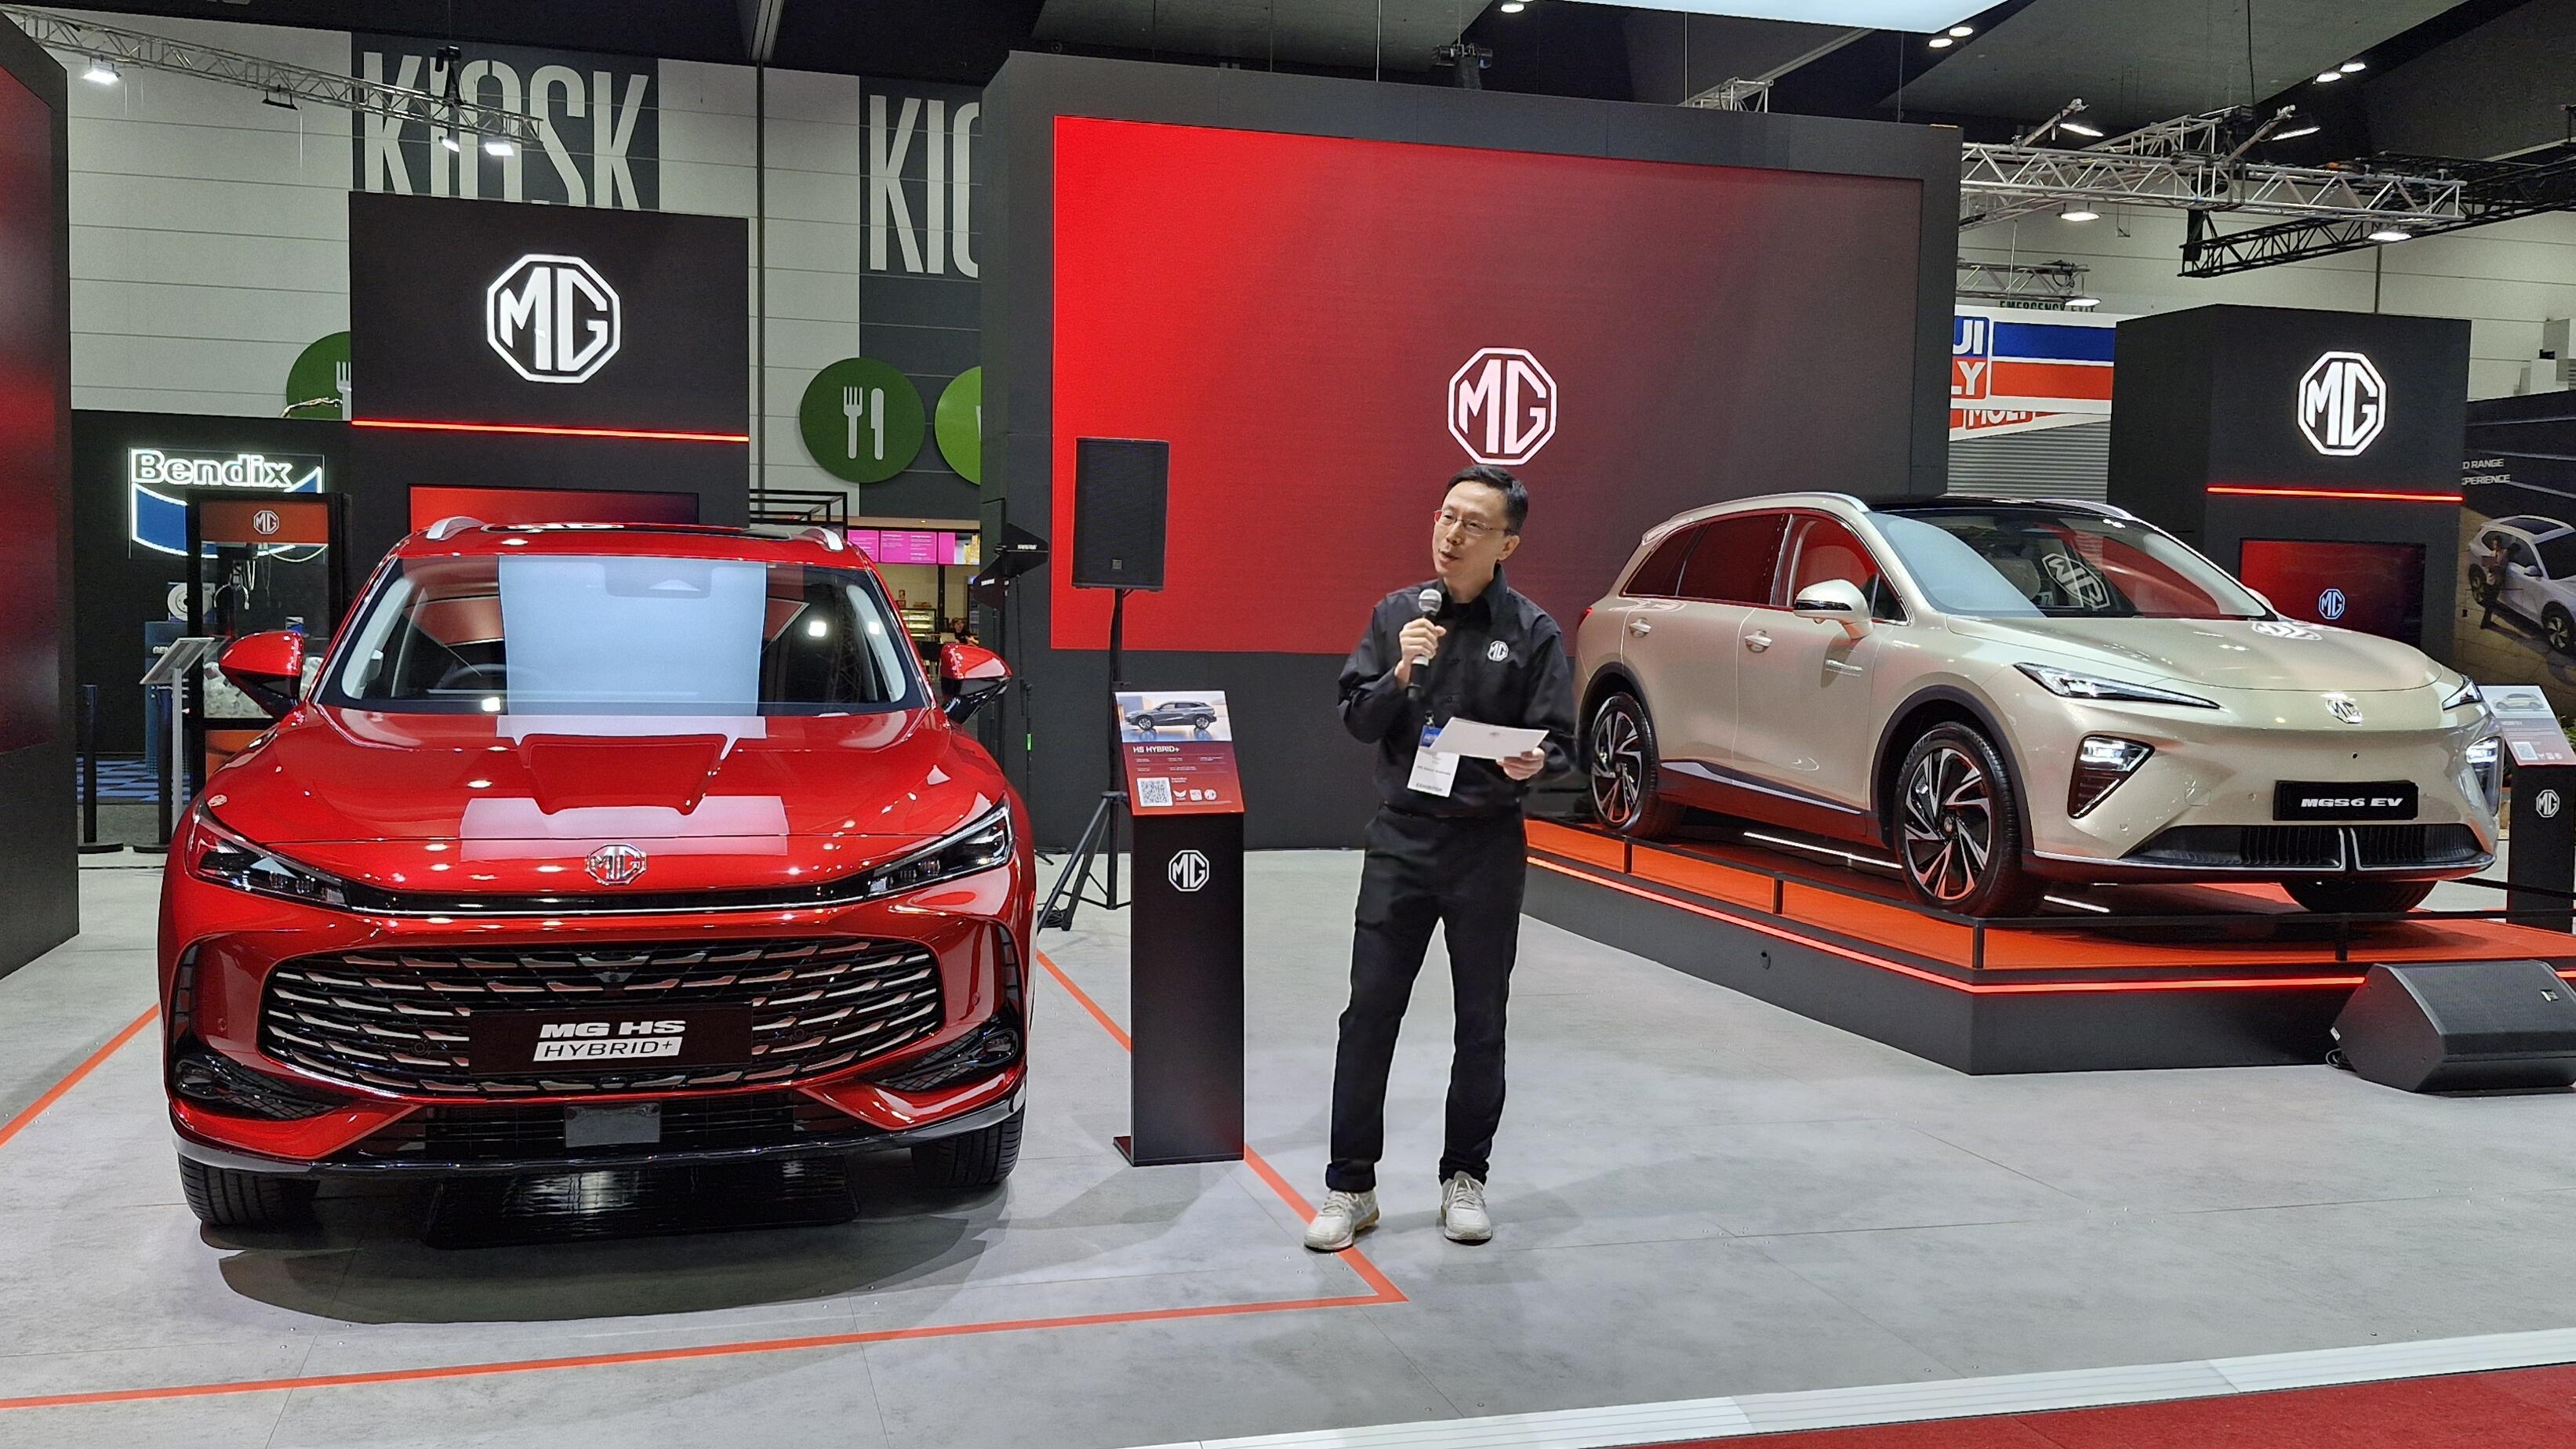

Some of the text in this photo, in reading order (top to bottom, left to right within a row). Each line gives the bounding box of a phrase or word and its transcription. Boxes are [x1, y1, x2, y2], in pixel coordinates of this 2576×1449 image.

[363, 52, 649, 210] KIOSK
[496, 262, 612, 375] MG
[1455, 356, 1550, 456] MG
[2304, 358, 2380, 448] MG
[131, 448, 294, 488] Bendix
[2471, 458, 2505, 468] RANGE
[256, 512, 278, 532] MG
[2320, 590, 2344, 618] MG
[1488, 641, 1507, 660] MG
[2301, 797, 2403, 808] MGS6 EV
[2538, 790, 2558, 816] MG
[587, 844, 645, 882] MG
[1172, 852, 1206, 888] MG
[540, 1020, 686, 1038] MG HS
[543, 1040, 674, 1058] HYBRID+
